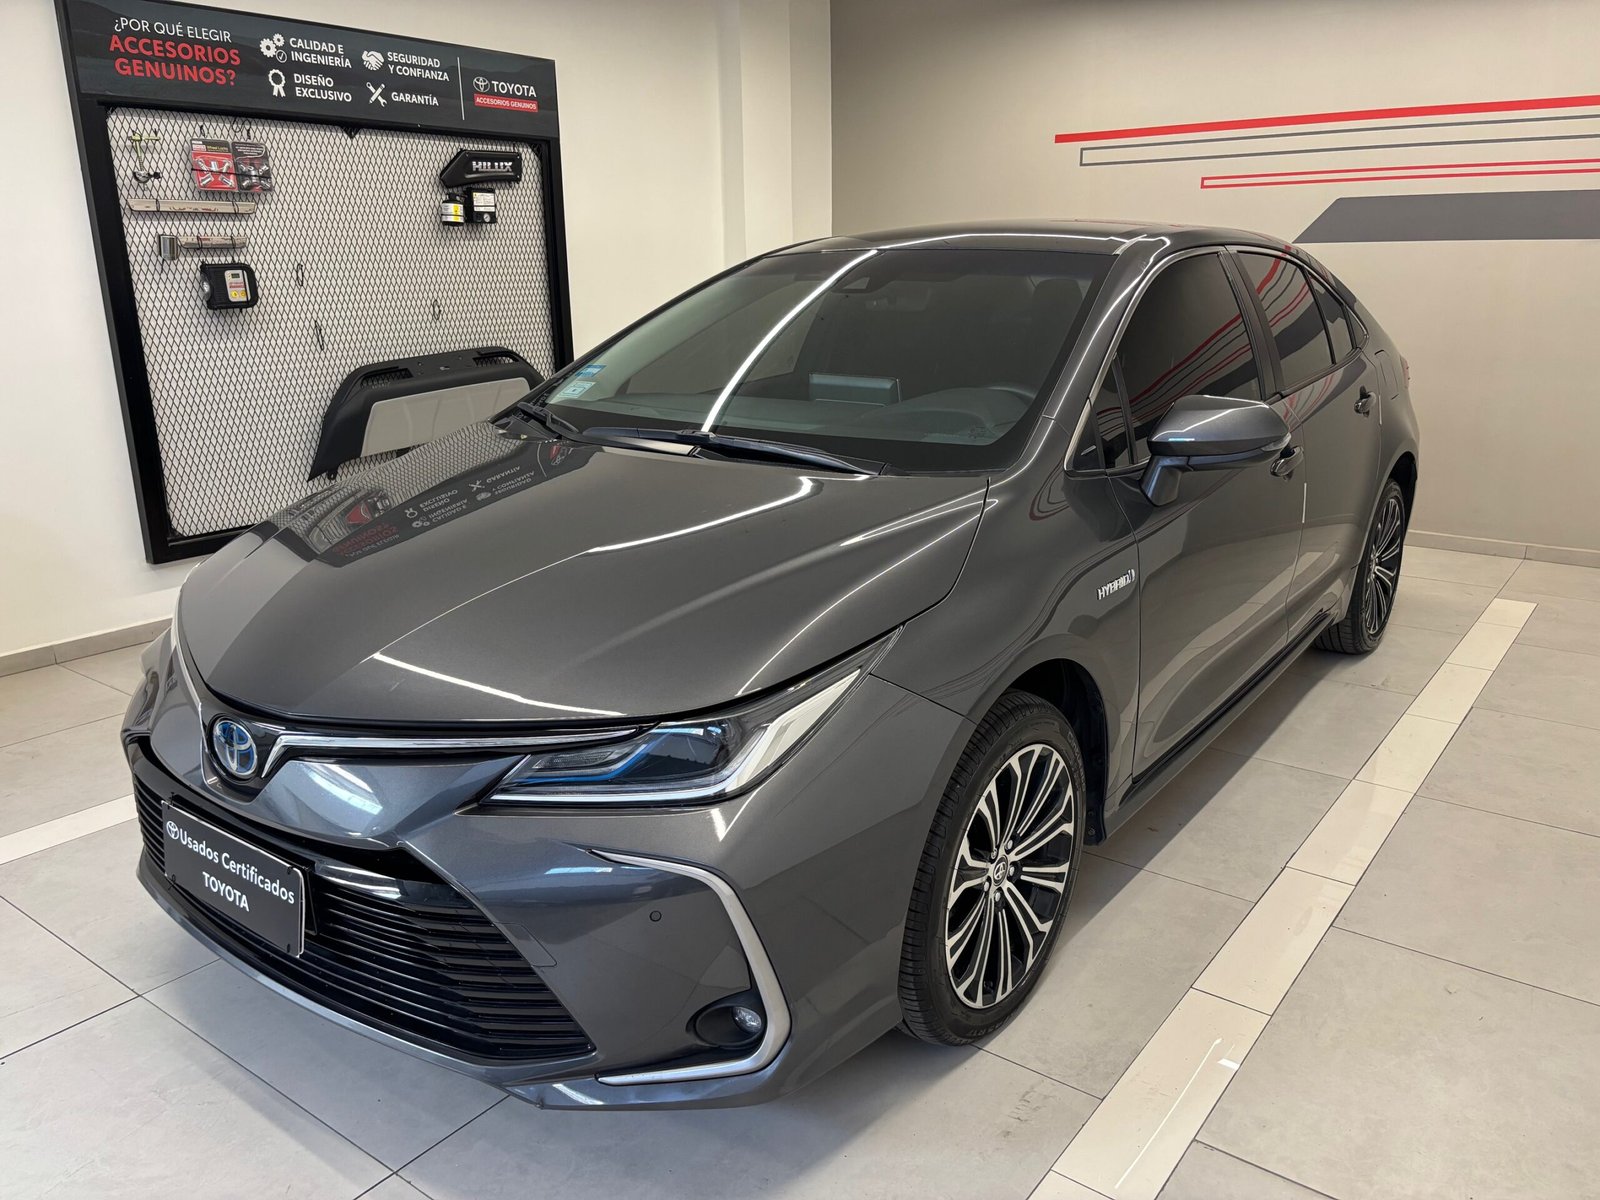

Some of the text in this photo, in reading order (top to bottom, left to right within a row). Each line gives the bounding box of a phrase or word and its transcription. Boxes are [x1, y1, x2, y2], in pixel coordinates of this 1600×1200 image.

[114, 17, 232, 43] ¿POR QUÉ ELEGIR
[109, 35, 241, 66] ACCESORIOS
[289, 37, 344, 55] CALIDAD E
[290, 51, 352, 69] INGENIERÍA
[387, 51, 441, 68] SEGURIDAD
[114, 58, 236, 86] GENUINOS?
[293, 73, 334, 88] DISEÑO
[388, 64, 450, 82] Y CONFIANZA
[295, 86, 352, 102] EXCLUSIVO
[491, 80, 537, 98] TOYOTA
[391, 92, 439, 107] GARANTÍA
[475, 97, 537, 110] ACCESORIOS GENUINOS
[472, 161, 513, 172] HILUX
[1097, 568, 1136, 600] HYBRID
[179, 828, 295, 904] Usados Certificados
[202, 871, 250, 912] TOYOTA
